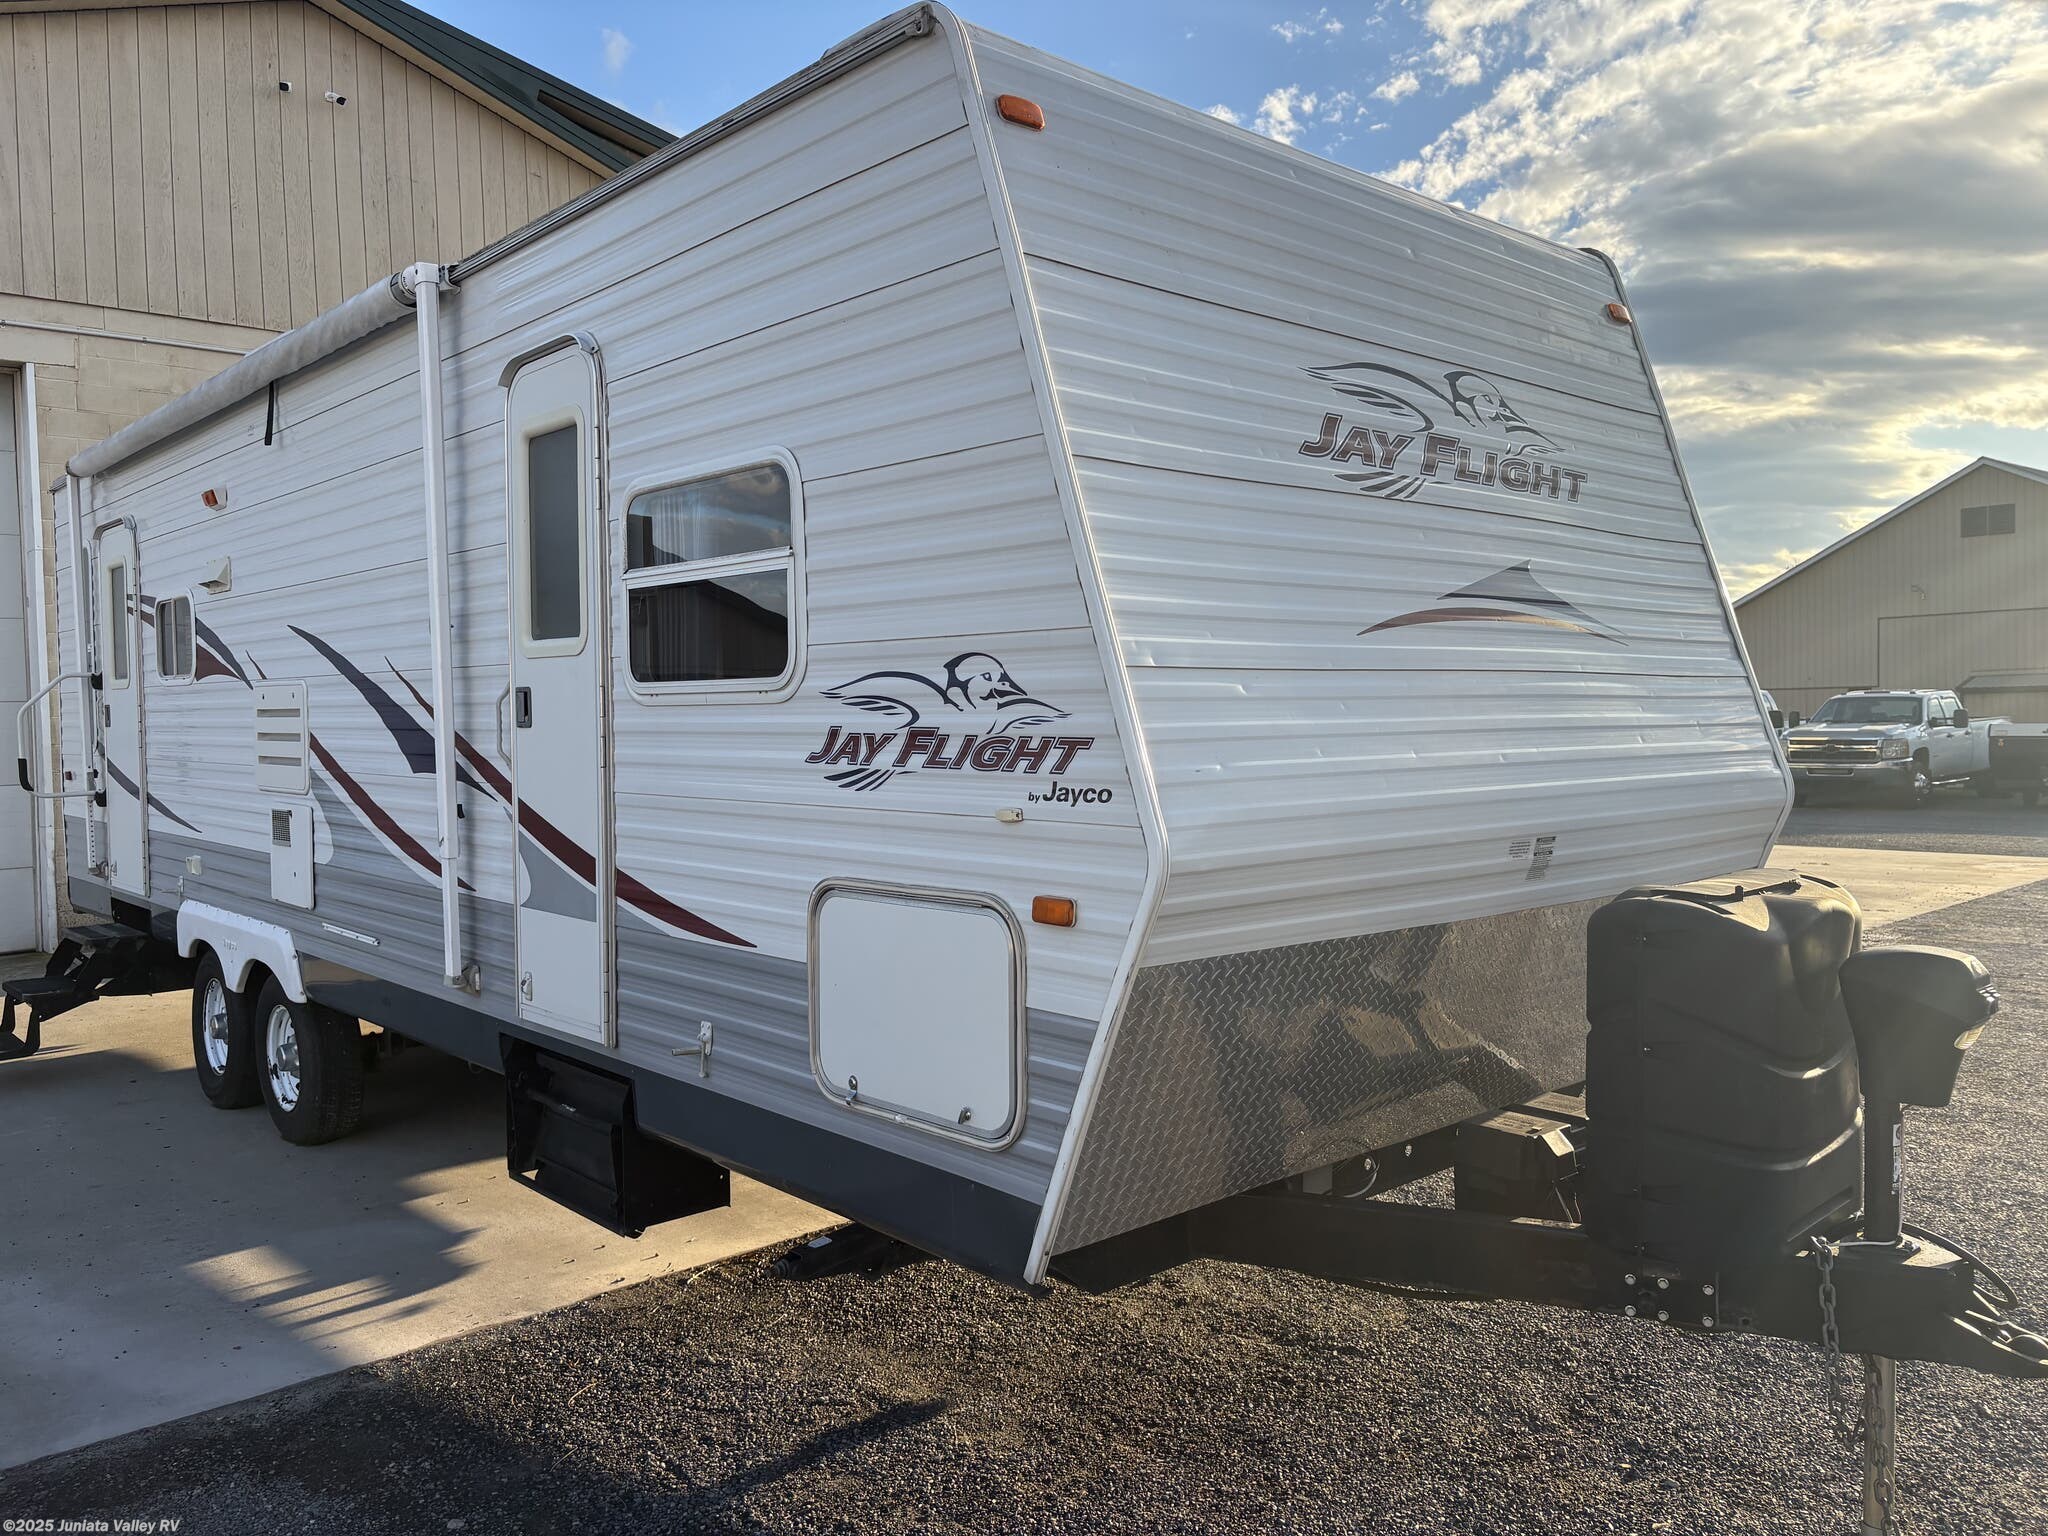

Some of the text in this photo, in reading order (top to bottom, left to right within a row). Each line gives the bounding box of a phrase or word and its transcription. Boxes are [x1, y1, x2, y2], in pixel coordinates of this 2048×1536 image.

[1298, 412, 1588, 503] JAY FLIGHT
[805, 725, 1095, 775] JAY FLIGHT
[1028, 781, 1113, 807] by Jayco
